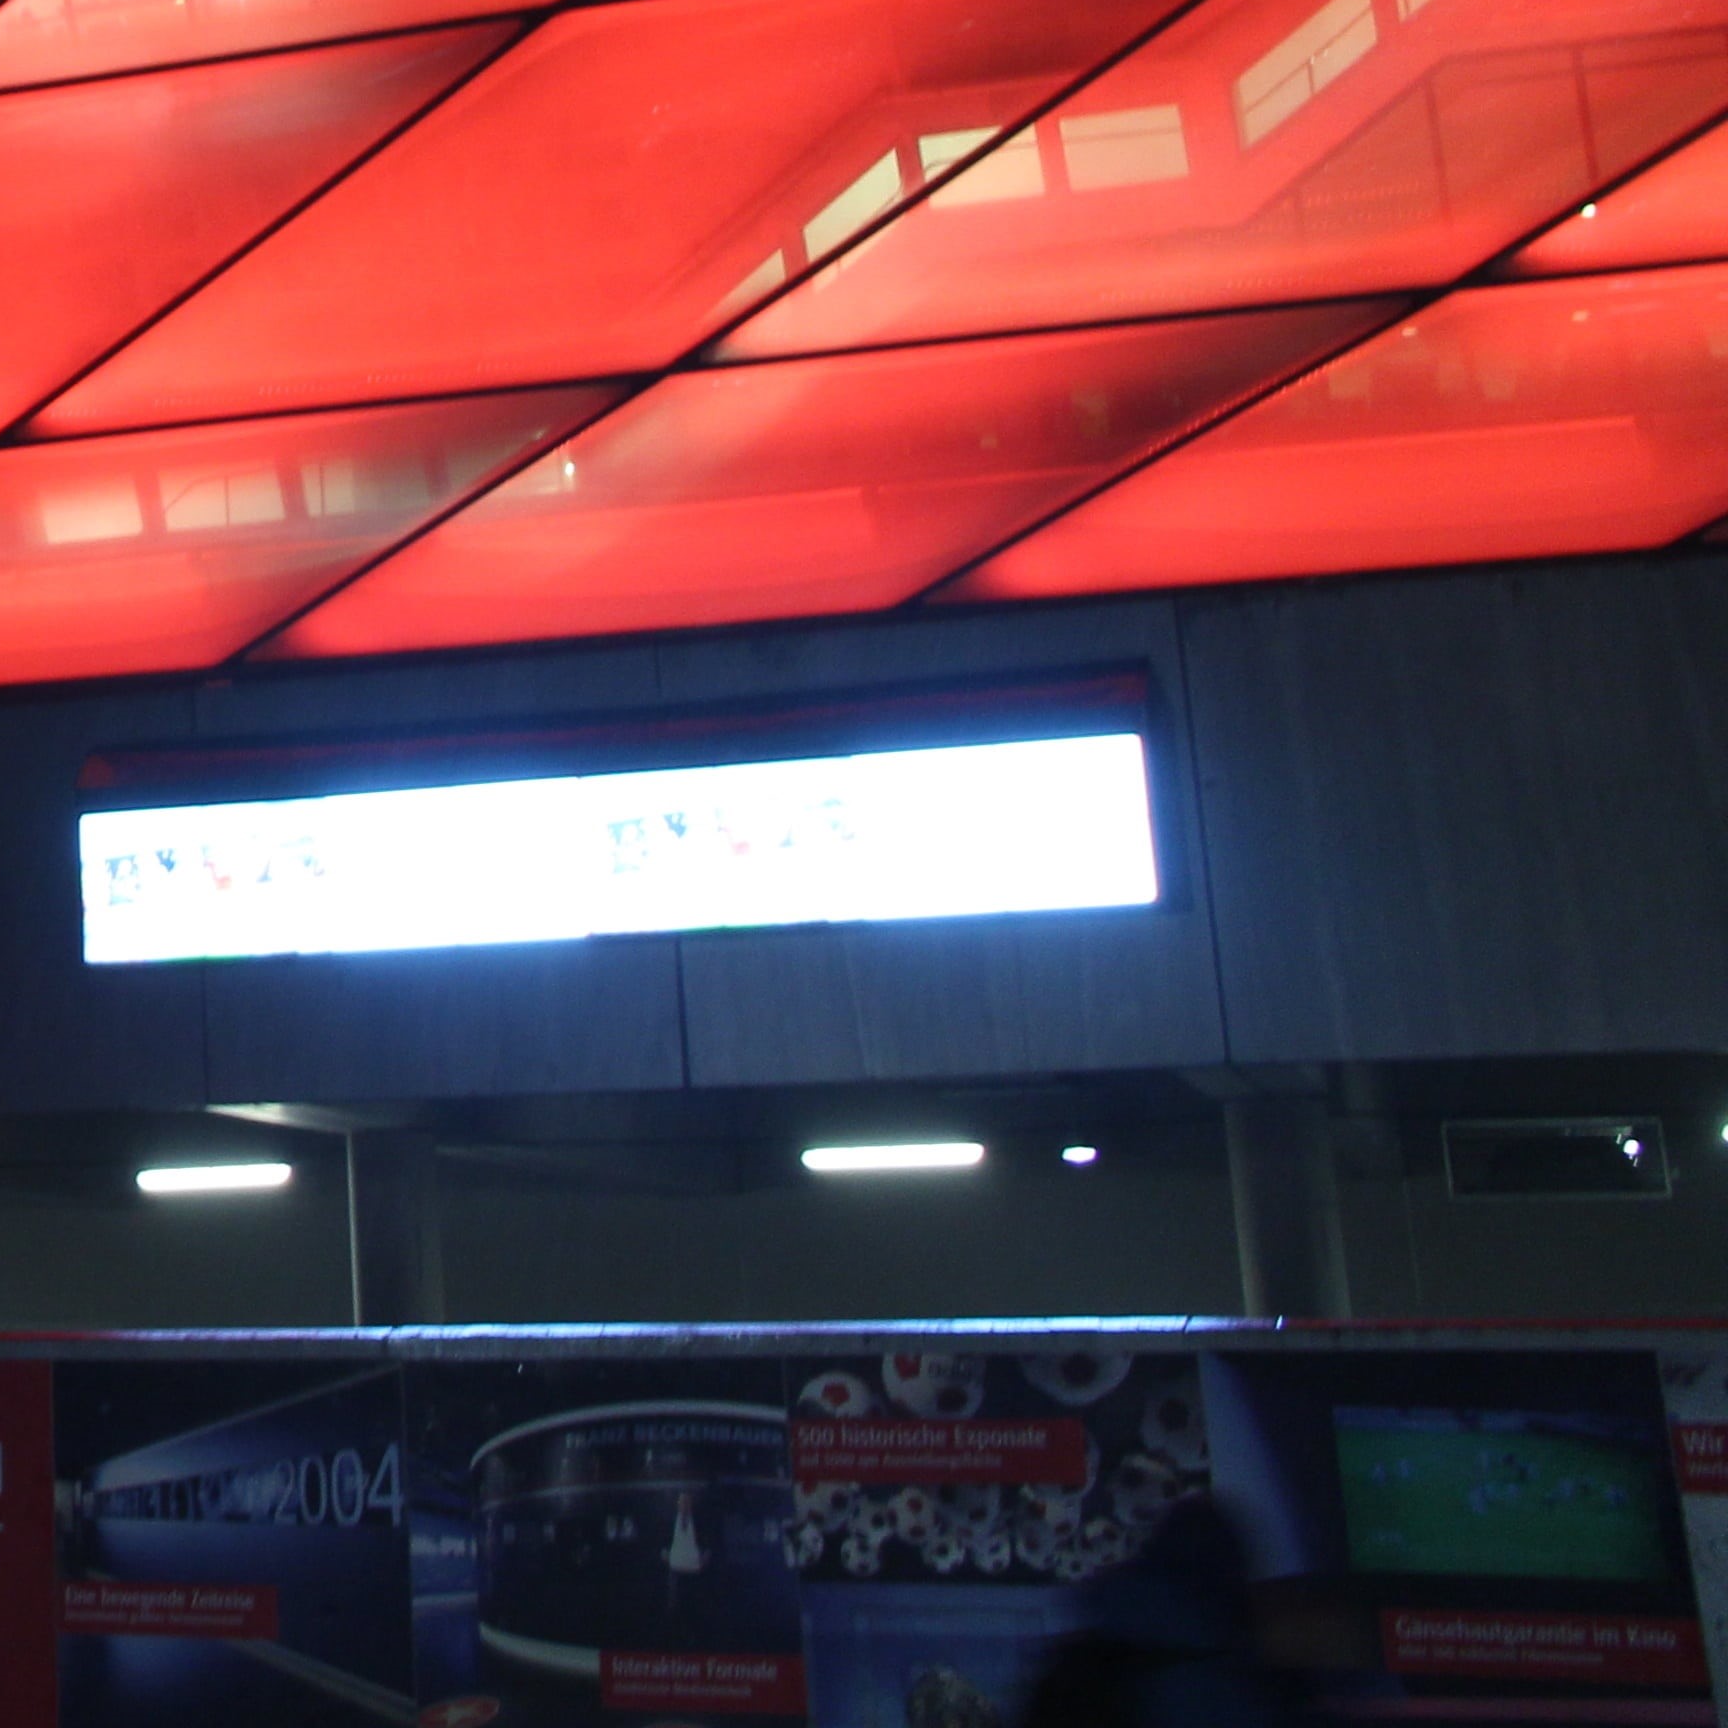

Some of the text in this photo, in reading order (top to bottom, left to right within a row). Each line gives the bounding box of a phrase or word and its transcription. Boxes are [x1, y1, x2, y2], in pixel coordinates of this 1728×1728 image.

[798, 1423, 1048, 1452] 500 historische Exponate
[274, 1440, 404, 1529] 2004
[1625, 1622, 1677, 1651] Kino
